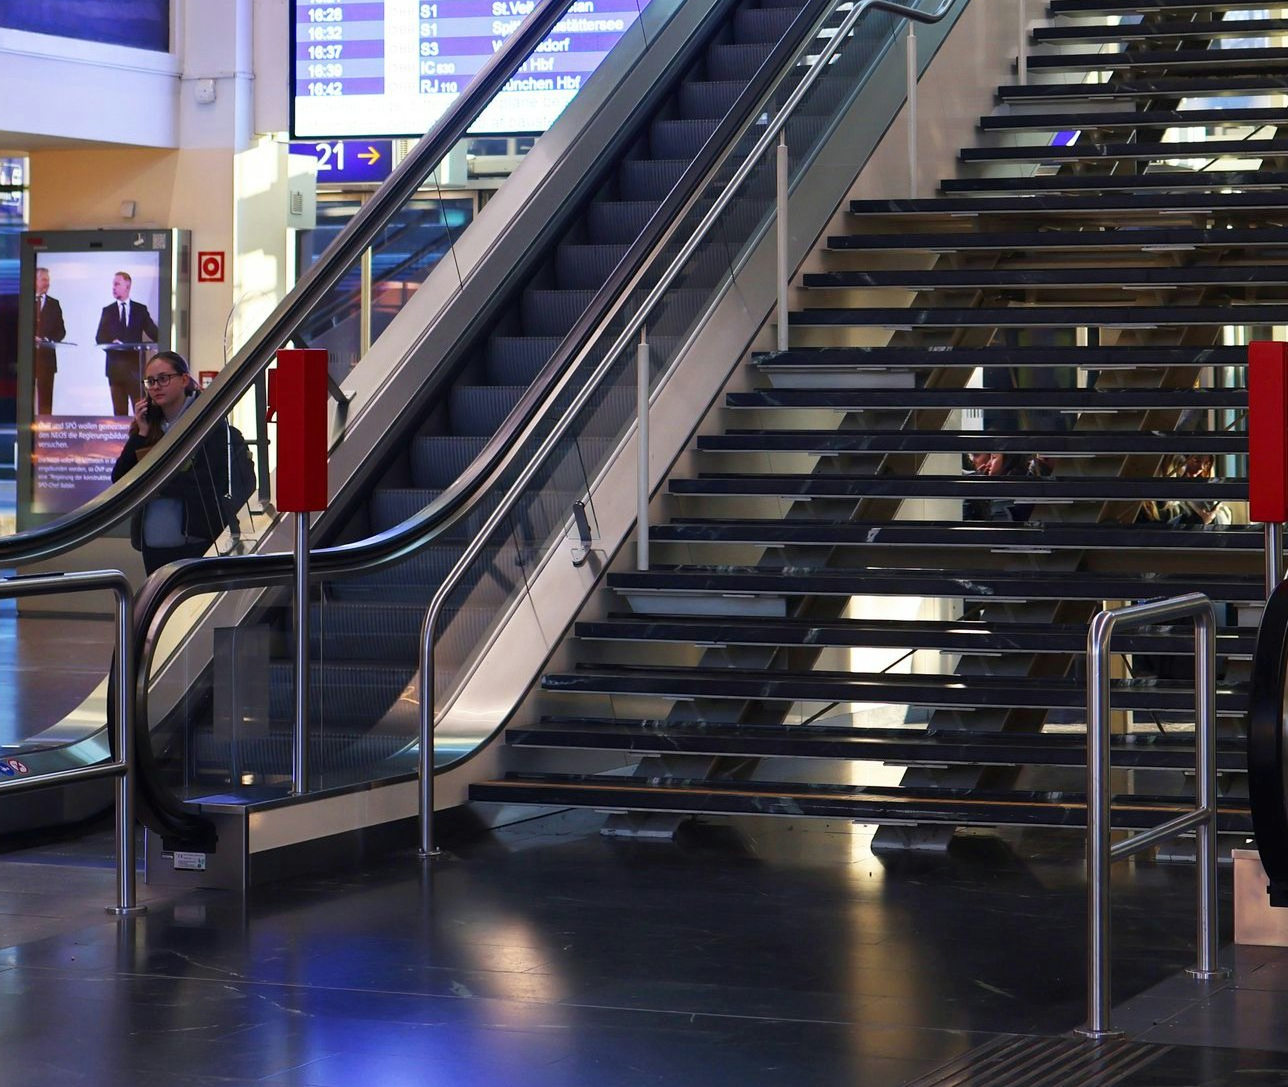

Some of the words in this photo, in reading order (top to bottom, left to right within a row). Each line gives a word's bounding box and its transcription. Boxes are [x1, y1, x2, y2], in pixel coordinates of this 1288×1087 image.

[420, 4, 437, 18] S1
[420, 23, 437, 37] S1
[420, 42, 439, 56] S3
[421, 61, 436, 75] IC
[530, 57, 554, 71] Hbf
[420, 80, 439, 93] RJ
[503, 77, 554, 92] ünchen
[557, 75, 582, 90] Hbf
[315, 141, 344, 170] 21
[79, 432, 130, 441] Regierungsbildun
